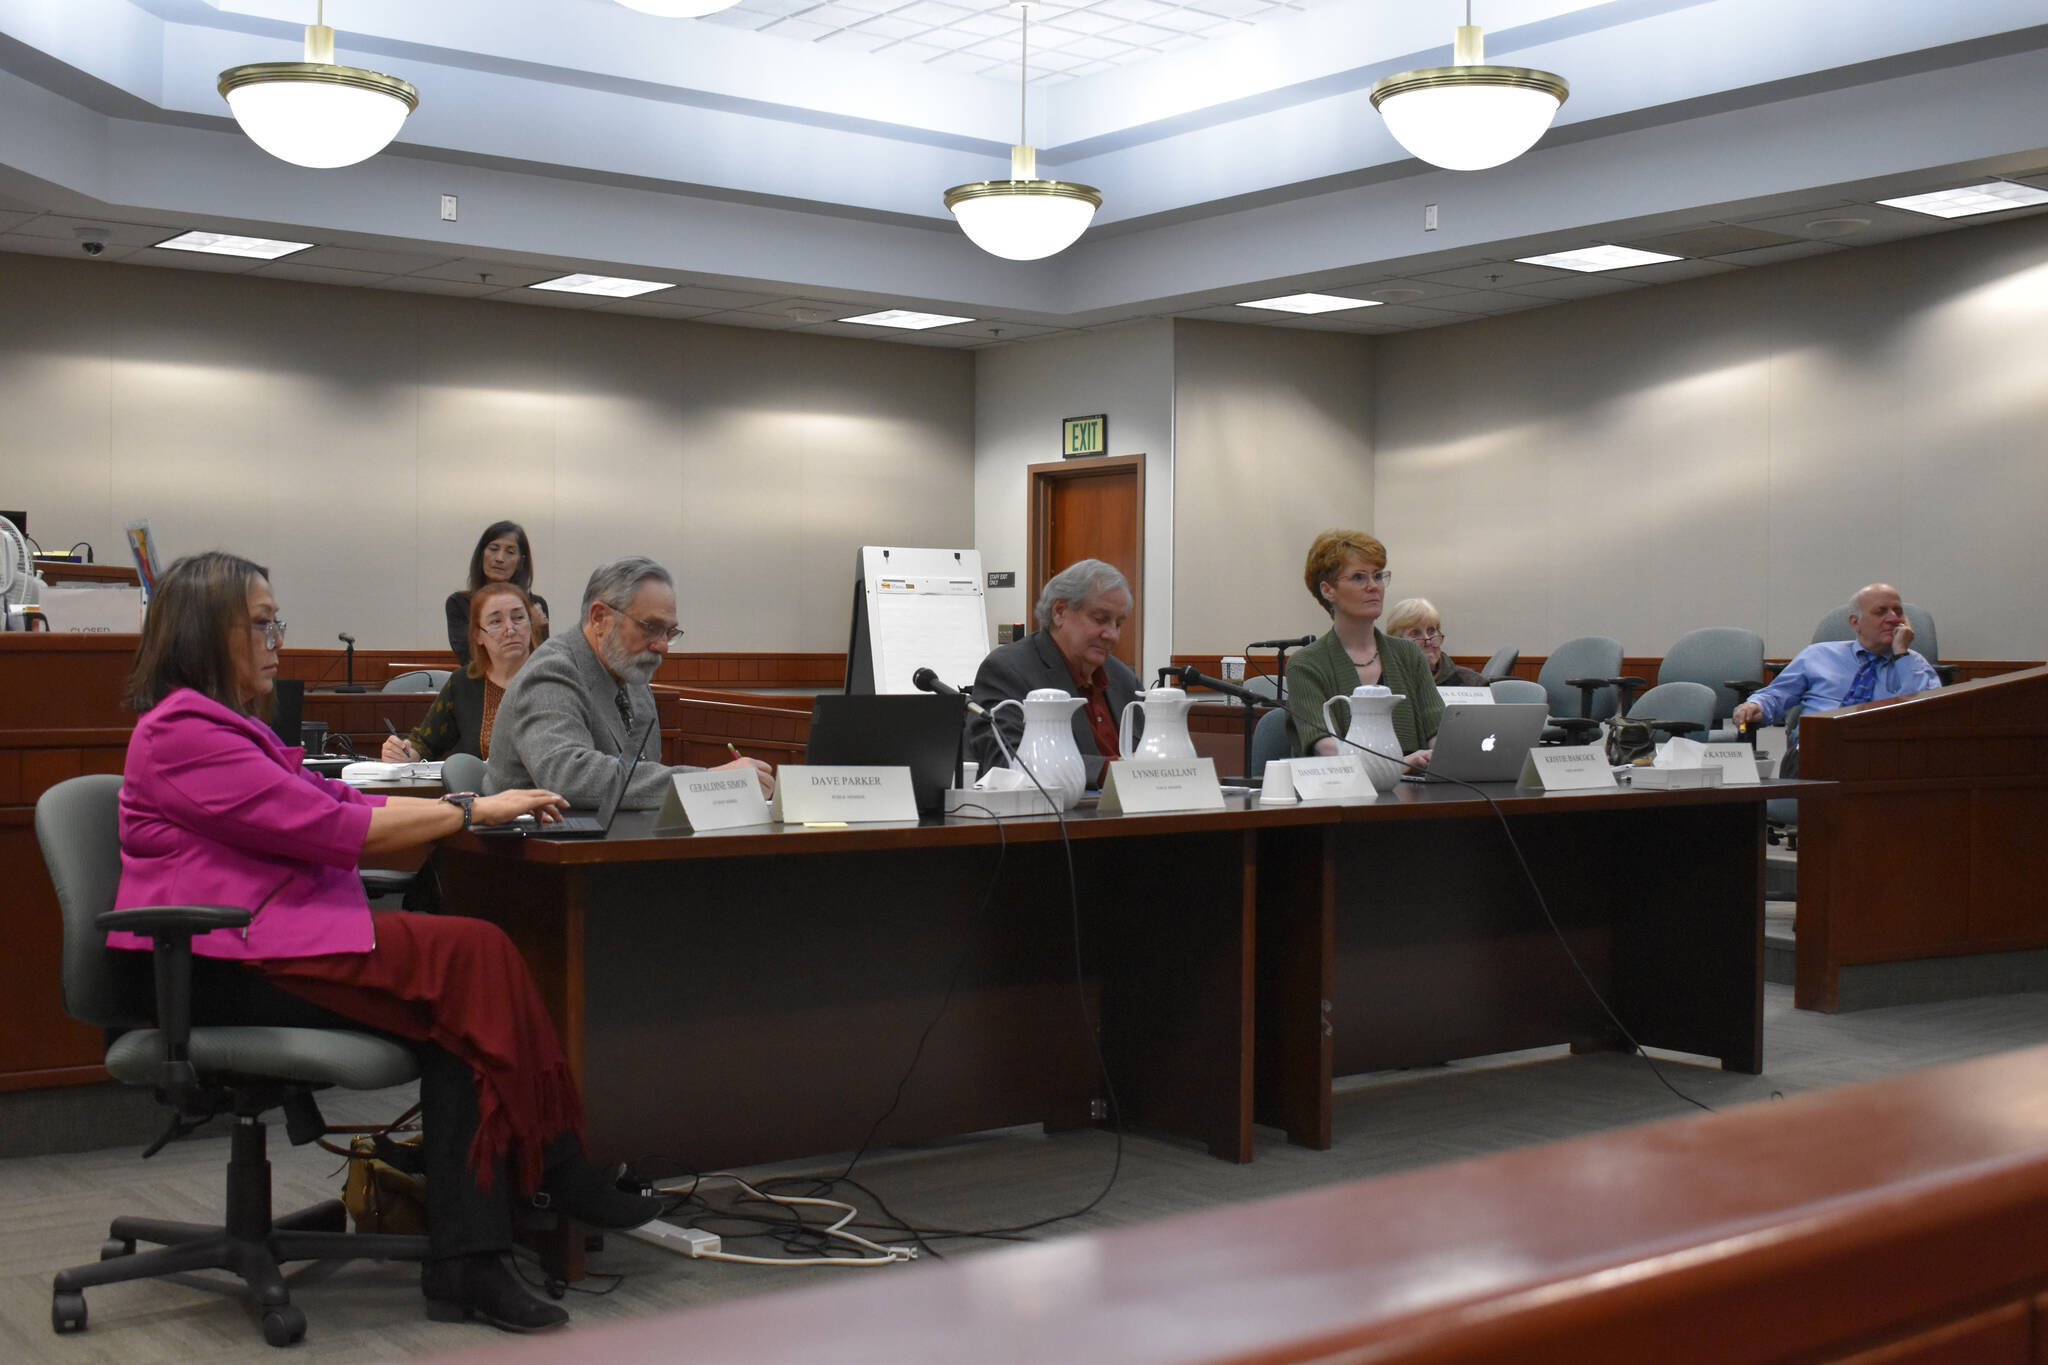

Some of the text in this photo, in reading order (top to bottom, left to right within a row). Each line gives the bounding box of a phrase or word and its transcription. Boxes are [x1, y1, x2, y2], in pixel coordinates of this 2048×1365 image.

[1072, 421, 1098, 452] EXIT
[1569, 754, 1596, 763] BABCOCK
[1708, 751, 1743, 759] KATCHER
[1131, 767, 1197, 779] LYNNE GALLANT
[1298, 768, 1321, 776] DANIEL
[811, 776, 881, 786] DAVE PARKER
[689, 780, 747, 793] GERALDINE SIMON
